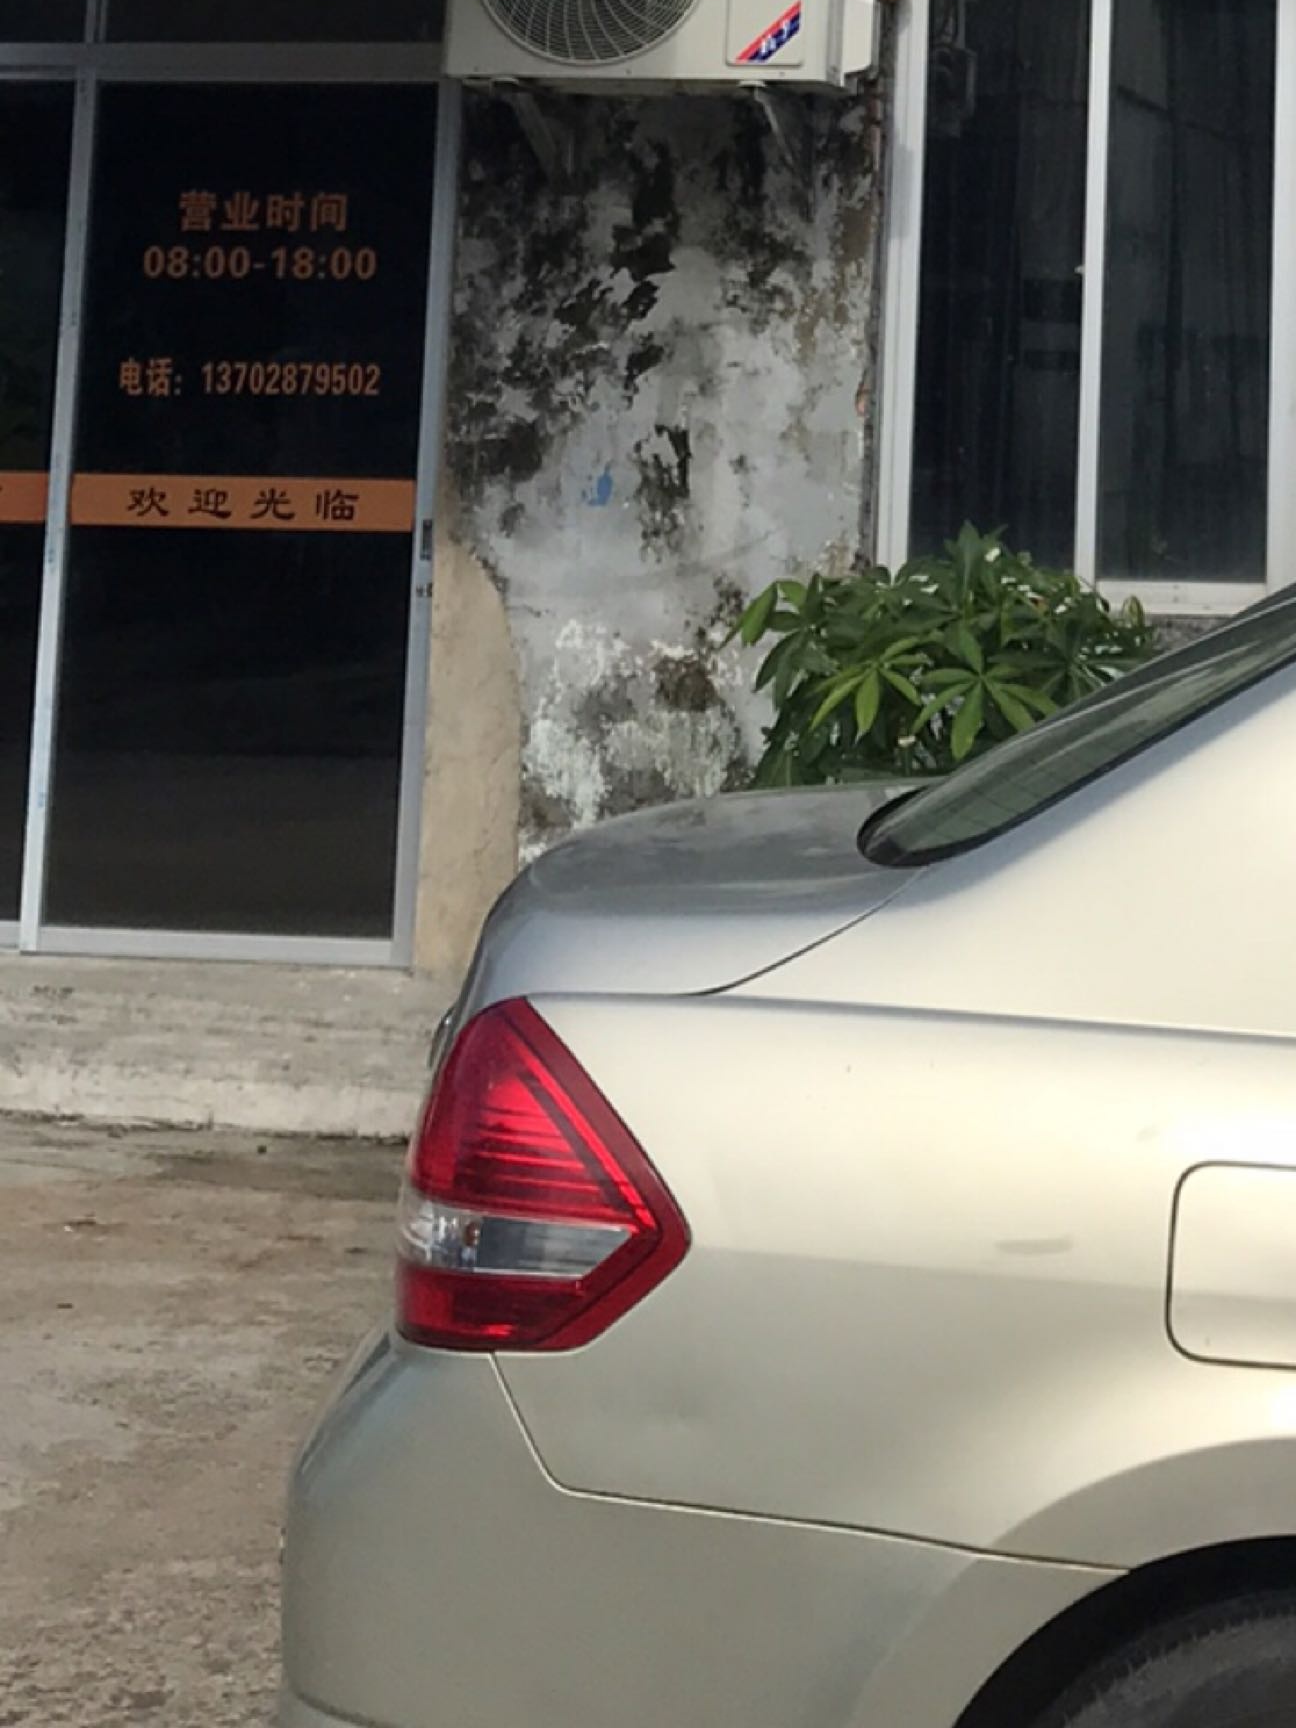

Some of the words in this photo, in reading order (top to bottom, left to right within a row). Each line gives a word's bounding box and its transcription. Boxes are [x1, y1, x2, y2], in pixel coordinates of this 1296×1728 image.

[178, 190, 349, 232] 营业时间
[143, 246, 377, 280] 08:00-18:00
[202, 362, 382, 396] 13702879502
[127, 487, 361, 523] 欢迎光临
